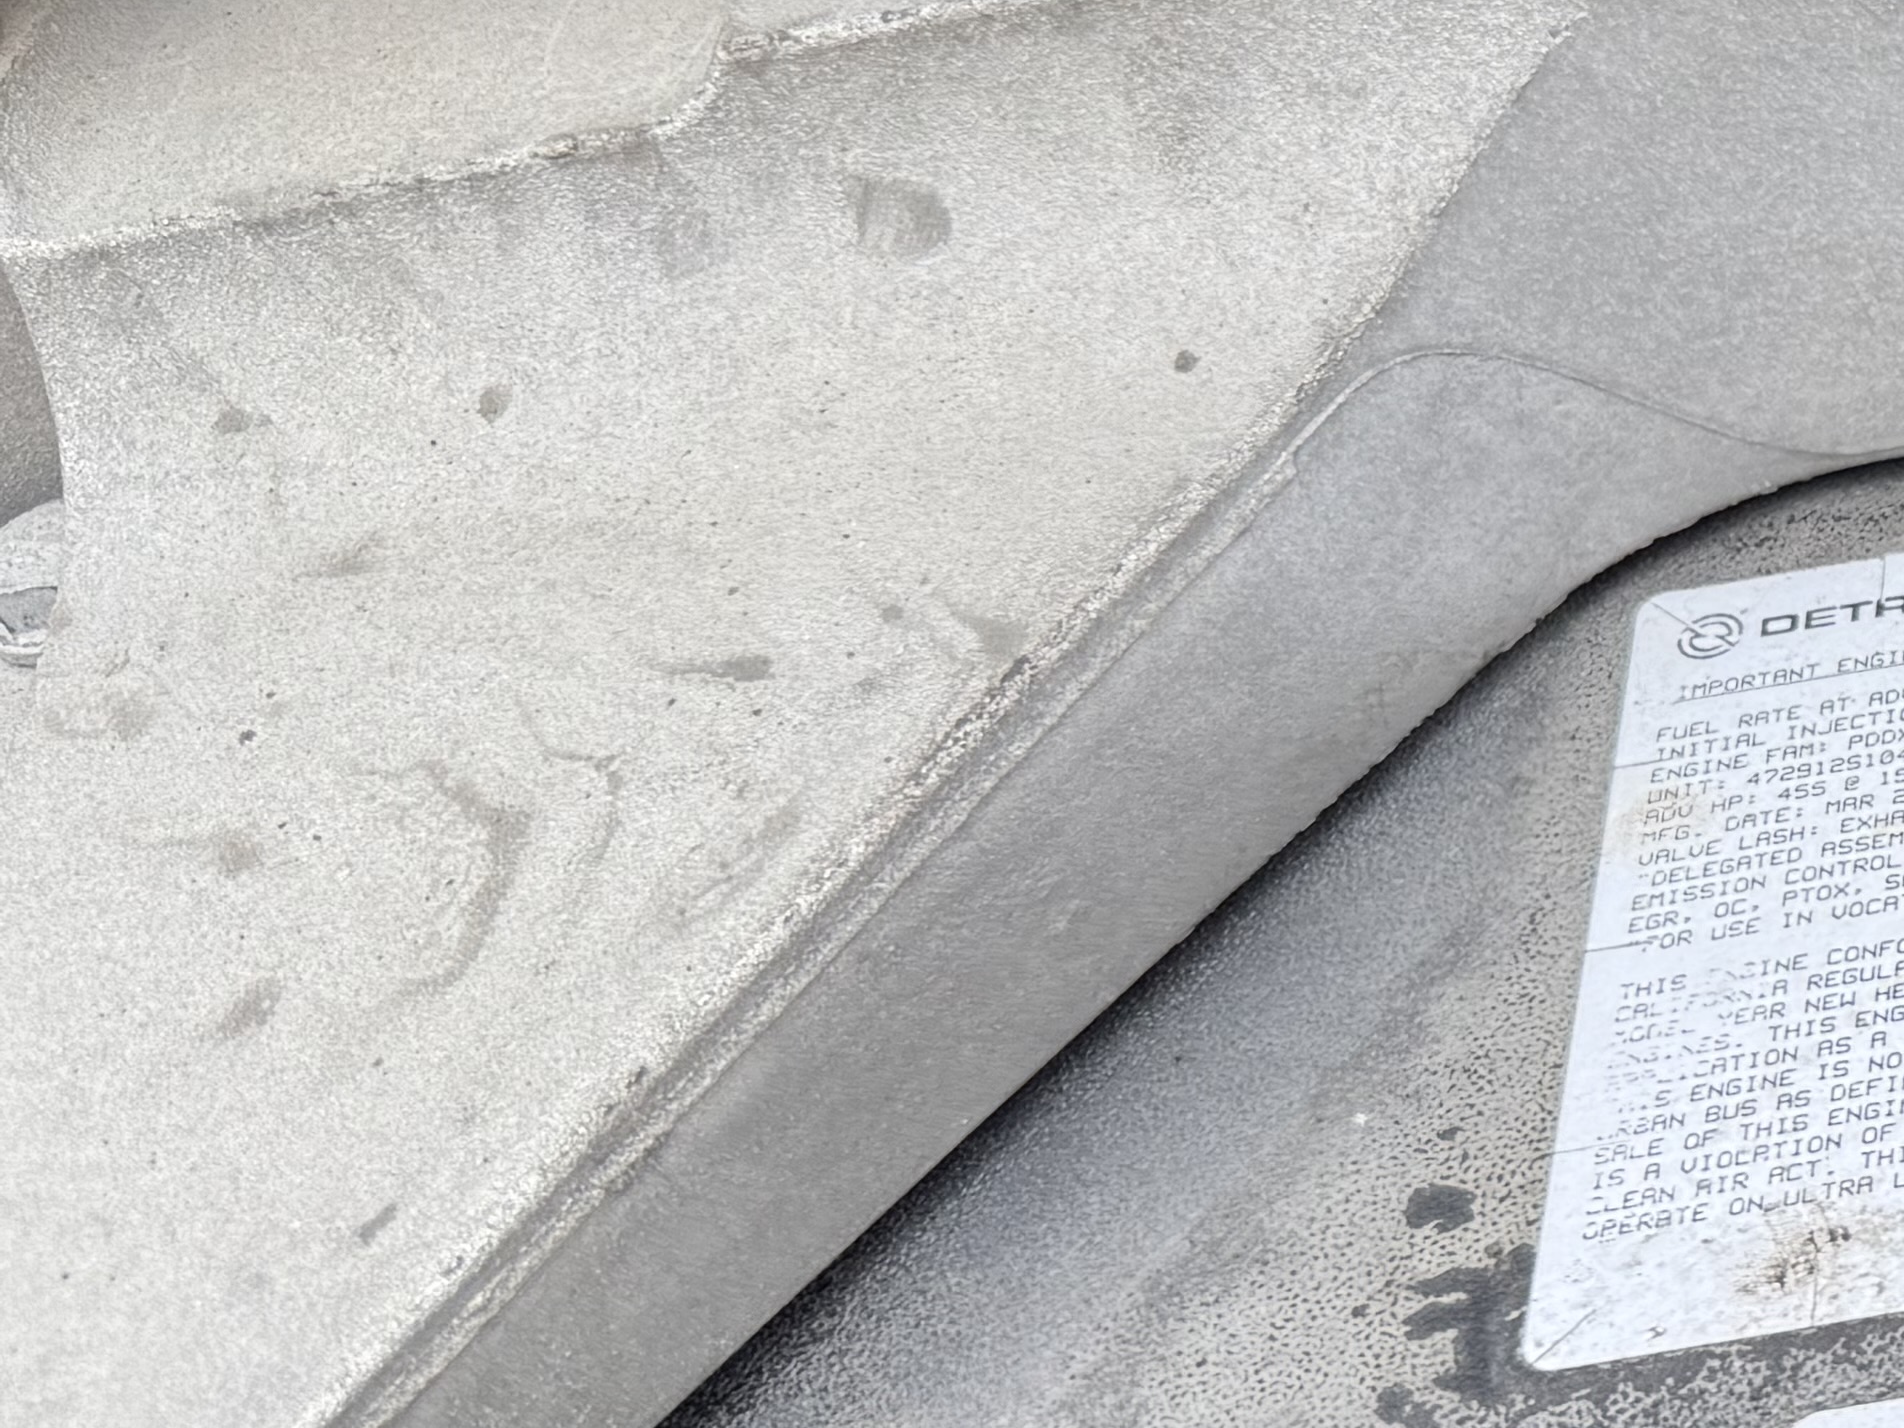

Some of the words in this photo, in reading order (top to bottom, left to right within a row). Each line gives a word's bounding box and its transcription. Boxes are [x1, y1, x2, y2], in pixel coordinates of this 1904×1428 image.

[1679, 662, 1823, 699] IMPORTANT
[1657, 718, 1721, 741] FUEL
[1738, 705, 1802, 728] RATE
[1651, 753, 1748, 782] ENGINE
[1766, 740, 1827, 764] FAM:
[1654, 730, 1767, 762] INITIAL
[1647, 777, 1726, 803] UNIT:
[1711, 792, 1757, 813] HP:
[1777, 781, 1826, 802] 455
[1641, 821, 1704, 845] MFG.
[1725, 805, 1804, 831] DATE:
[1825, 794, 1874, 815] MAR
[1638, 839, 1721, 866] VALVE
[1739, 823, 1819, 850] LASH:
[1632, 874, 1766, 909] EMISSION
[1784, 852, 1901, 885] CONTROL
[1635, 847, 1802, 888] "DELEGATED
[1711, 917, 1761, 940] USE
[1618, 973, 1687, 999] THIS
[1804, 990, 1855, 1014] NEW
[1766, 1016, 1835, 1042] THIS
[1690, 1069, 1795, 1101] ENGINE
[1704, 1098, 1757, 1122] BUS
[1594, 1137, 1665, 1164] SALE
[1737, 1114, 1808, 1141] THIS
[1695, 1171, 1749, 1196] AIR
[1768, 1157, 1836, 1184] ACT.
[1783, 1176, 1873, 1207] ULTRA
